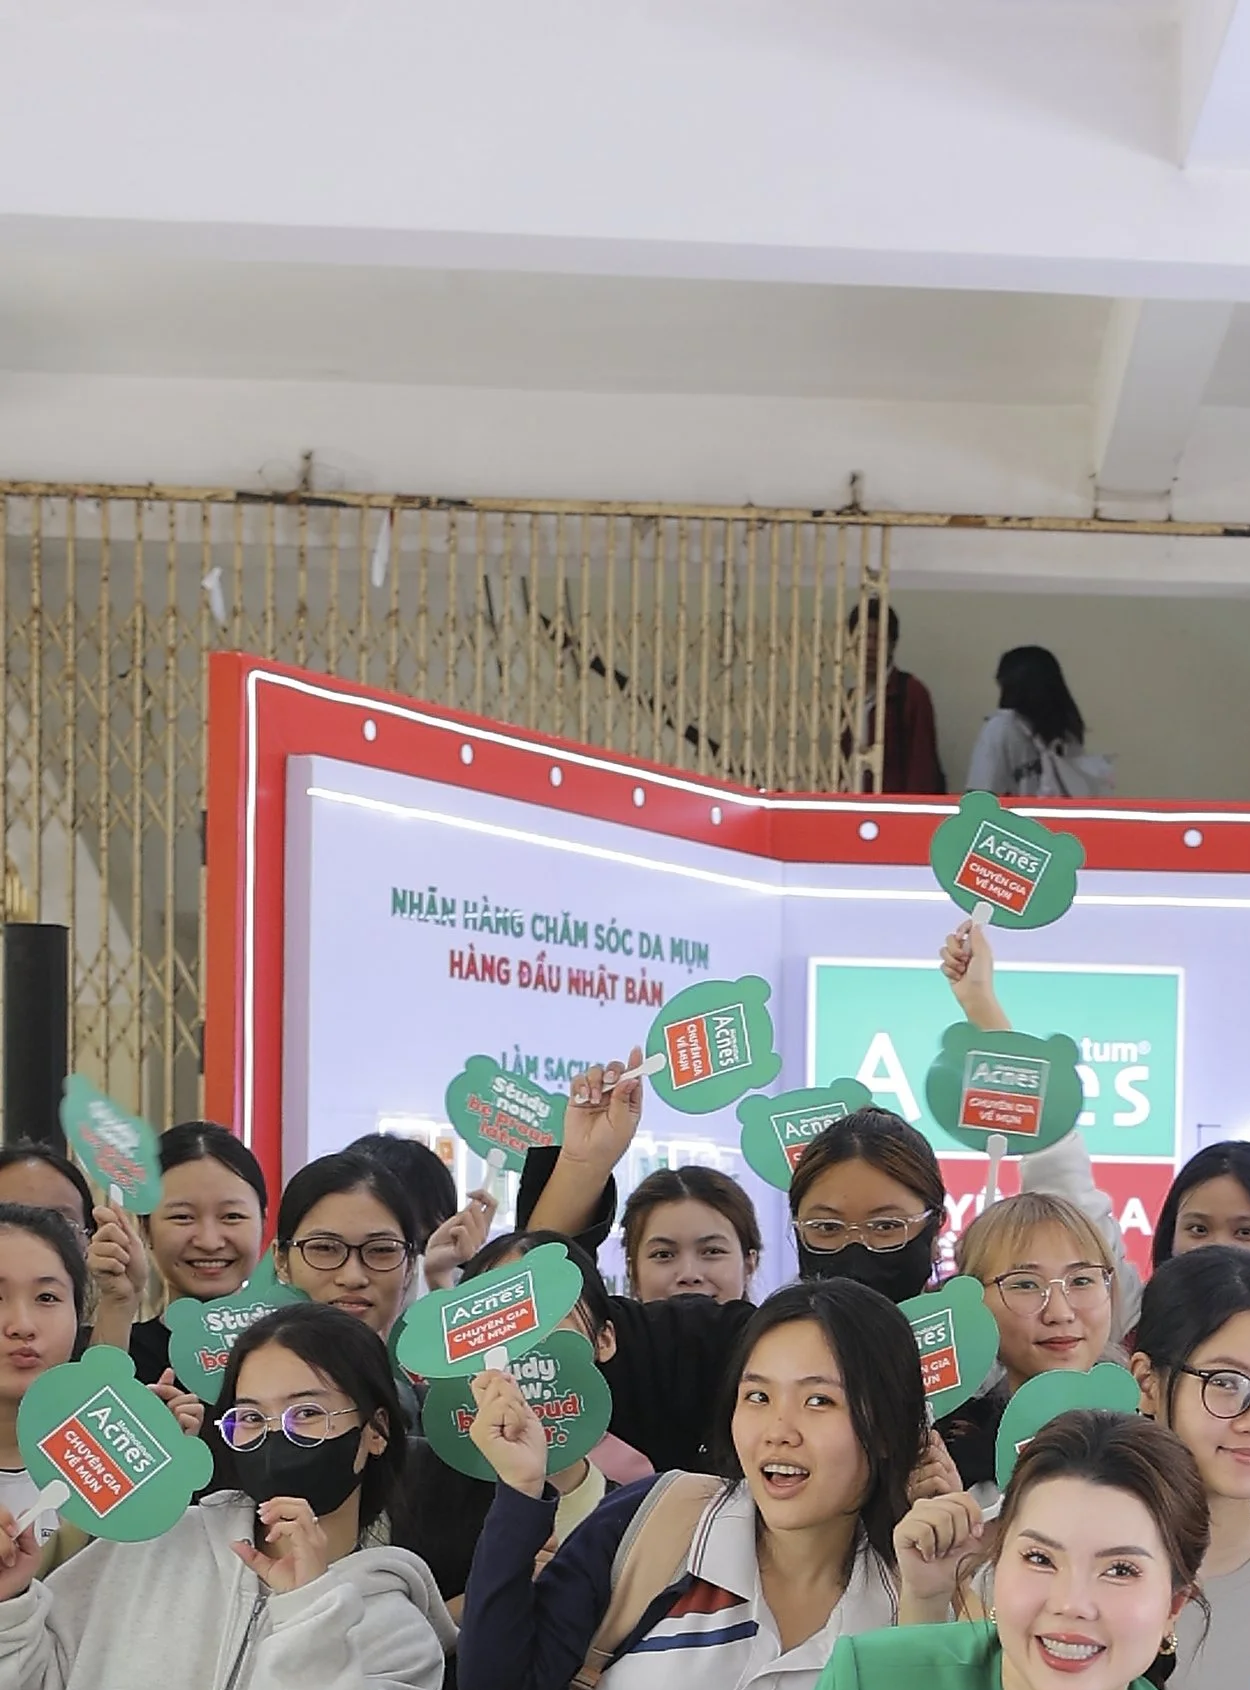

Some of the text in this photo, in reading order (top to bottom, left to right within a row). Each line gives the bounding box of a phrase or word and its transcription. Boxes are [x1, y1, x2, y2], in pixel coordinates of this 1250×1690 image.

[978, 835, 1040, 873] Acnes
[969, 862, 1026, 895] CHUYÊN GIA
[391, 886, 710, 974] NHÃN HÀNG CHĂM SÓC DA MỤN
[449, 943, 664, 1007] HÀNG ĐẦU NHẬT BẢN
[712, 1017, 734, 1066] Acnes
[491, 1075, 549, 1118] Study
[468, 1093, 554, 1146] be proud
[785, 1115, 842, 1138] Acne
[451, 1284, 525, 1324] Acnes
[506, 1308, 528, 1321] GIA
[930, 1357, 950, 1371] GIA
[87, 1407, 151, 1473] Acnes
[64, 1430, 122, 1495] CHUYÊN GIA
[76, 1465, 103, 1493] MỤN
